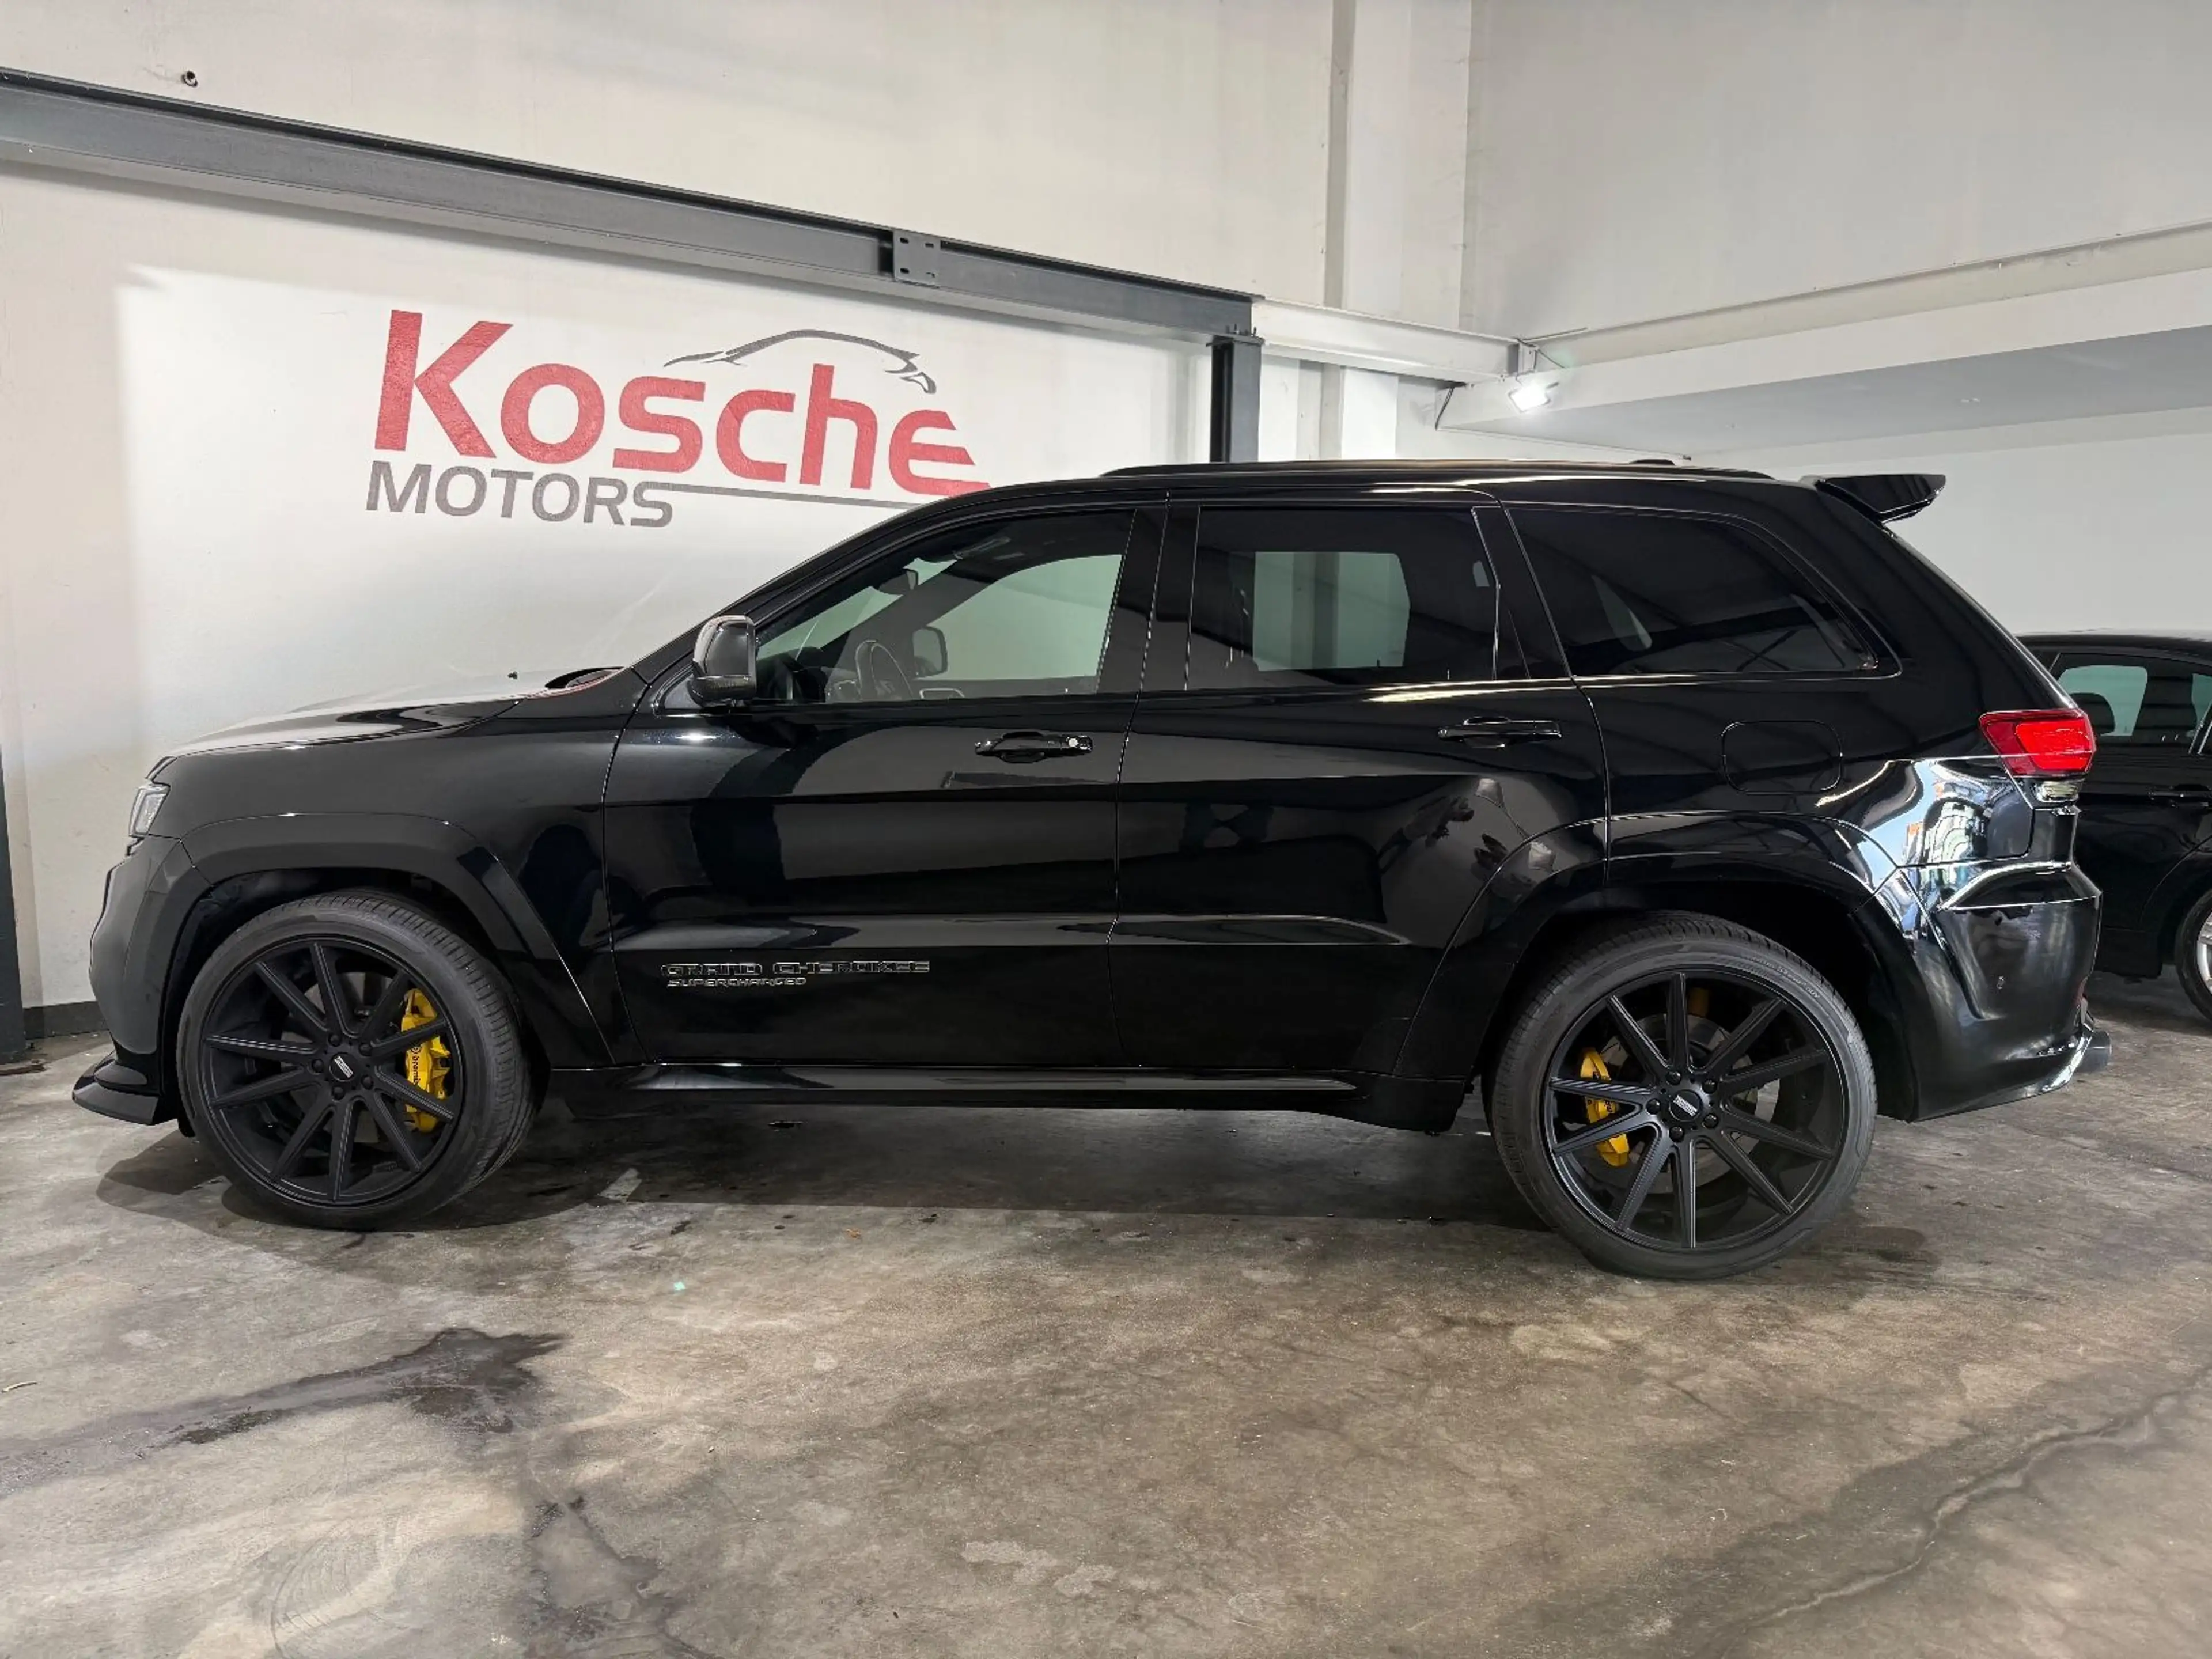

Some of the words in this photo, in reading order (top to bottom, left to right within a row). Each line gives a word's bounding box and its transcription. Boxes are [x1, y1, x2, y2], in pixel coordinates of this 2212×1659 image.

[374, 309, 992, 497] Kosche
[365, 460, 674, 528] MOTORS
[666, 976, 806, 988] SUPERCHARGED
[412, 1055, 422, 1085] bremb
